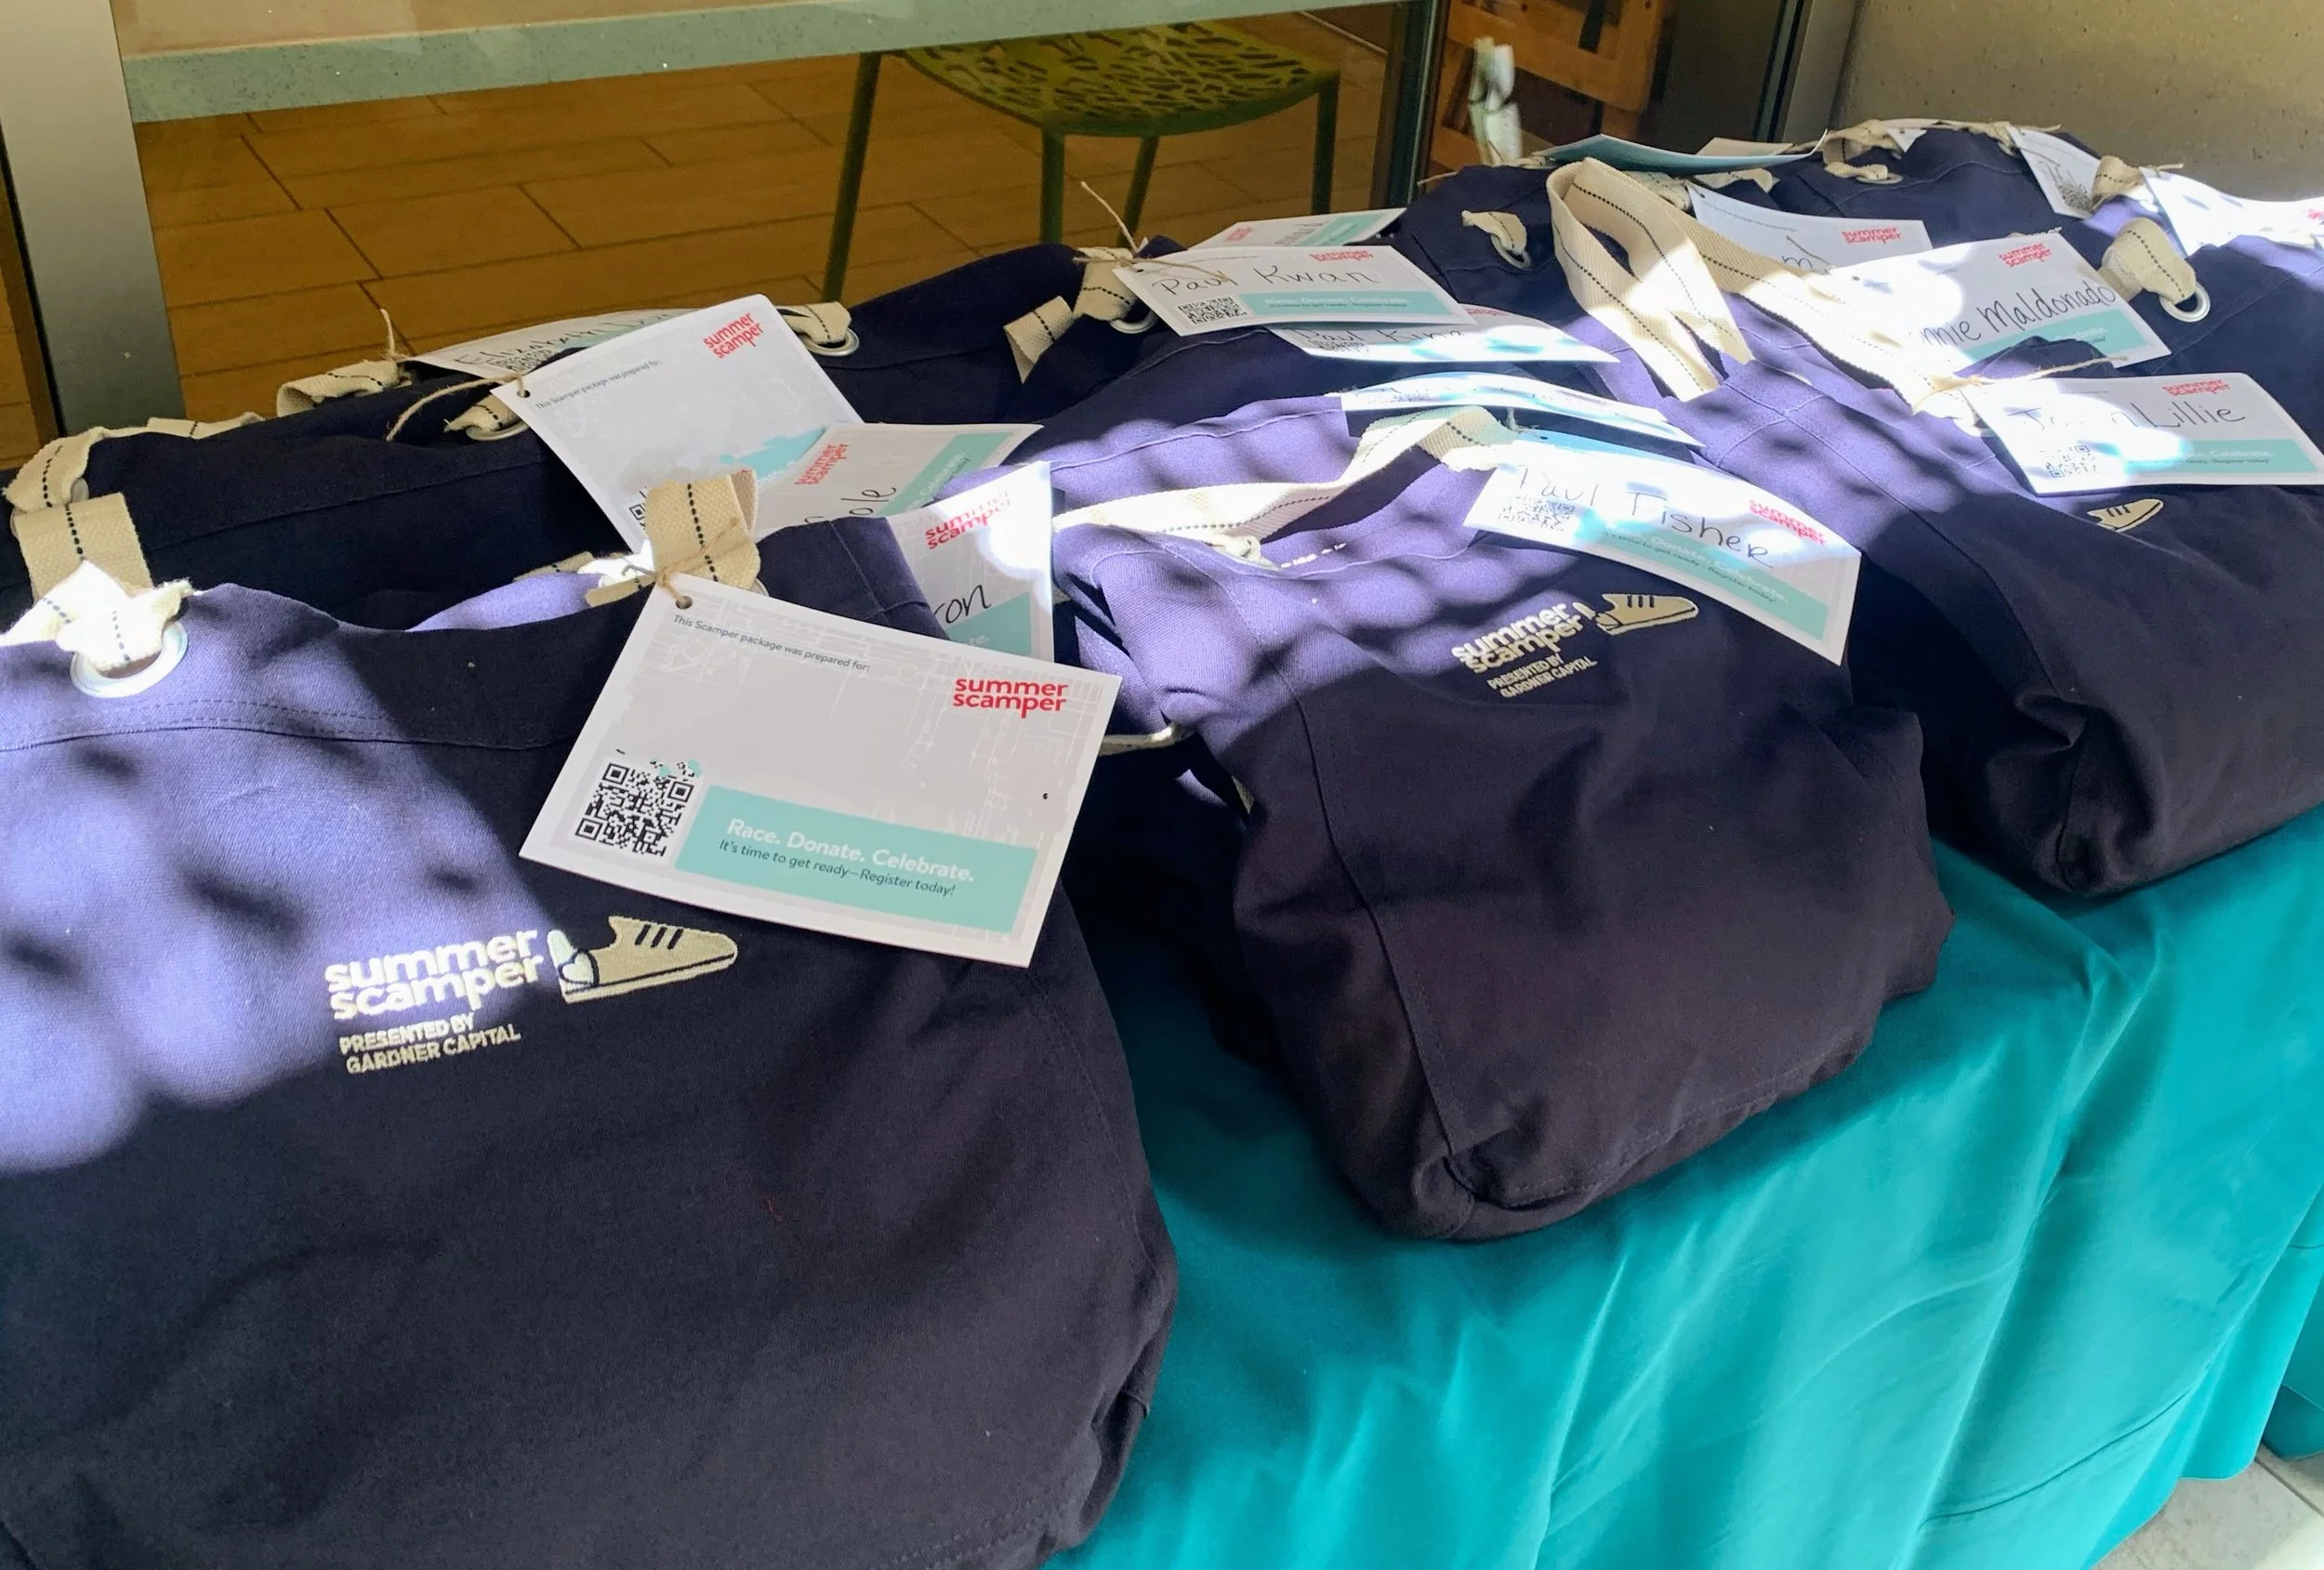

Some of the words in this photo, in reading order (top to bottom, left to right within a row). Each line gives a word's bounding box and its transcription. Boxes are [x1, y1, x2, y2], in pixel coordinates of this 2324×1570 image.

[1152, 270, 1239, 296] Paul
[1253, 264, 1380, 284] Kwan
[703, 312, 754, 349] summer
[1976, 280, 2117, 334] Maldonado
[713, 323, 763, 359] scamper
[2130, 401, 2247, 429] Lillie
[673, 613, 693, 628] This
[696, 620, 740, 640] Scamper
[740, 633, 783, 652] package
[785, 645, 803, 657] was
[803, 651, 852, 668] prepared
[852, 660, 871, 672] for:
[1451, 602, 1571, 663] summer
[1465, 613, 1583, 674] scamper
[954, 678, 1069, 696] summer
[1487, 659, 1551, 690] PRESENTED
[1546, 653, 1565, 668] BY
[1499, 671, 1555, 698] GARDNER
[1552, 655, 1598, 679] CAPITAL
[952, 693, 1067, 719] scamper
[719, 838, 738, 854] It's
[741, 844, 771, 861] time
[772, 851, 787, 864] to
[788, 856, 812, 869] get
[915, 879, 957, 898] today!
[725, 817, 782, 846] Race.
[786, 831, 866, 864] Donate.
[872, 848, 976, 883] Celebrate.
[325, 929, 538, 993] summer
[330, 955, 545, 1021] scamper
[338, 1019, 451, 1056] PRESENTED
[450, 1011, 476, 1036] BY
[345, 1041, 442, 1075] GARDNER
[442, 1023, 522, 1056] CAPITAL
